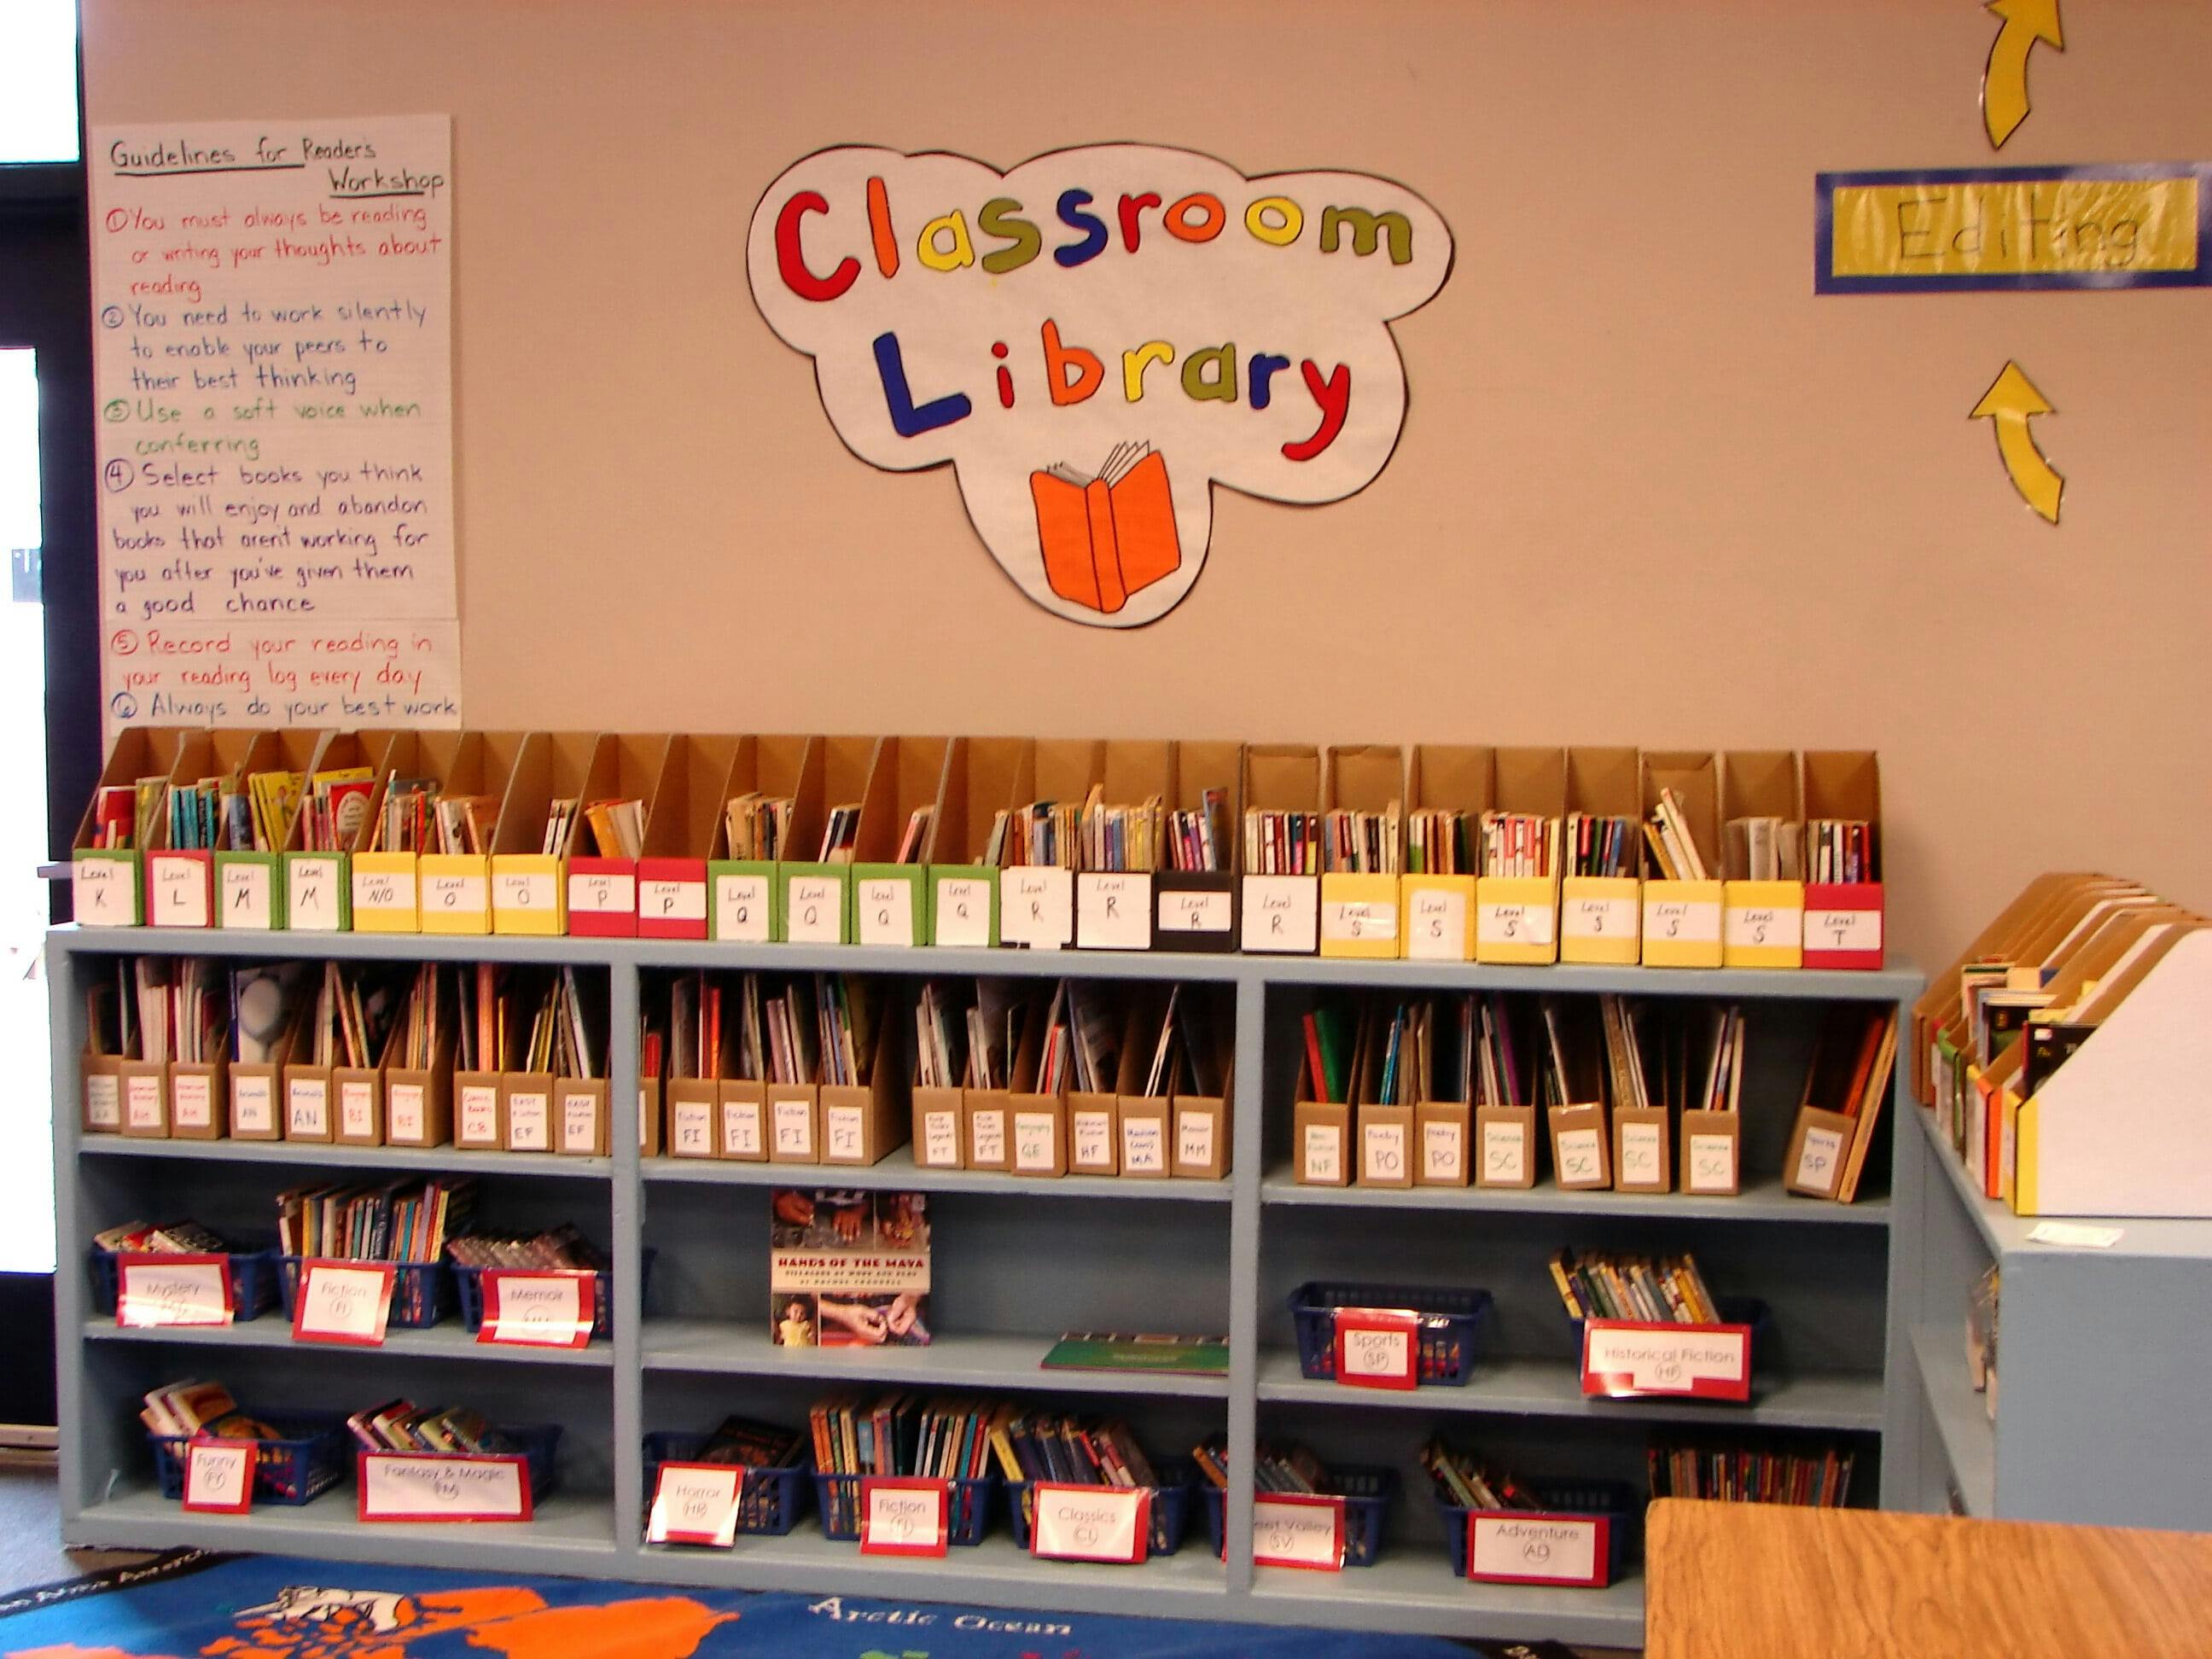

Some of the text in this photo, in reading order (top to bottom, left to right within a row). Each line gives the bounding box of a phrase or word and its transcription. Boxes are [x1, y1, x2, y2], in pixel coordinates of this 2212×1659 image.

[111, 140, 235, 167] Guidelines
[257, 137, 286, 163] for
[329, 169, 444, 199] Workshop
[129, 205, 428, 230] You must always be reading
[1897, 192, 2139, 267] Editing
[775, 177, 1412, 301] Classroom
[132, 236, 443, 268] or writing your thoughts about
[131, 275, 201, 303] reading
[129, 303, 426, 327] You need to work silently
[131, 329, 387, 364] to enable your peers to
[132, 364, 356, 395] their best thinking
[873, 318, 1352, 462] Library
[137, 399, 421, 422] Use a soft voice when
[136, 432, 259, 460] conferring
[143, 463, 422, 489] Select books you think
[130, 495, 428, 524] you will enjoy and abandon
[113, 528, 166, 550] books
[182, 526, 224, 550] that
[301, 532, 377, 556] working
[393, 523, 429, 545] for
[115, 557, 414, 591] you after you've given them
[116, 592, 315, 620] a good chance
[148, 631, 433, 661] Record your reading in
[123, 663, 423, 694] your reading log every day
[152, 693, 457, 725] Always do your best work
[81, 866, 114, 881] Level
[162, 867, 190, 882] Level
[227, 870, 254, 884] Level
[299, 865, 324, 877] Level
[362, 876, 390, 887] Level
[437, 877, 465, 889] Level
[506, 877, 530, 887] Level
[589, 876, 612, 888] Level
[655, 882, 681, 895] Level
[949, 882, 971, 896] Level
[1021, 879, 1046, 894] Level
[1097, 879, 1126, 892] Level
[95, 888, 107, 908] K
[173, 888, 186, 905] L
[236, 888, 251, 909] M
[300, 888, 319, 910] M
[369, 888, 393, 904] N/O
[444, 892, 456, 905] O
[518, 888, 530, 905] O
[598, 890, 608, 908] P
[728, 886, 755, 901] Level
[800, 887, 825, 901] Level
[871, 886, 894, 901] Level
[1263, 894, 1292, 910] Level
[663, 898, 674, 913] P
[957, 902, 968, 918] Q
[1031, 900, 1044, 923] R
[1107, 896, 1119, 918] R
[1181, 896, 1209, 910] Level
[1420, 898, 1447, 914] Level
[1495, 905, 1525, 918] Level
[1580, 901, 1610, 913] Level
[1656, 903, 1687, 917] Level
[737, 906, 748, 923] Q
[805, 907, 818, 925] Q
[878, 909, 890, 926] Q
[1190, 912, 1202, 929] R
[1339, 904, 1371, 920] Level
[1744, 910, 1773, 923] Level
[1824, 914, 1856, 927] Level
[1272, 916, 1284, 935] R
[1352, 920, 1361, 938] S
[1430, 920, 1442, 938] S
[1505, 920, 1517, 938] S
[1593, 916, 1603, 932] S
[1667, 919, 1678, 936] S
[1754, 925, 1766, 944] S
[1834, 928, 1846, 946] T
[294, 1110, 317, 1126] AN
[684, 1128, 701, 1144] FI
[731, 1129, 752, 1146] FI
[781, 1128, 802, 1144] FI
[1375, 1150, 1399, 1170] PO
[1430, 1150, 1455, 1167] PO
[778, 1259, 923, 1267] HANDS OF THE MAYA
[322, 1282, 366, 1298] Fiction
[1353, 1332, 1400, 1348] Sports
[1605, 1348, 1733, 1362] Historical Fiction
[197, 1453, 237, 1470] Funny
[879, 1499, 925, 1512] Fiction
[1058, 1507, 1116, 1522] Classics
[1496, 1525, 1579, 1540] Adventure
[808, 1597, 1071, 1635] Arctic Ocean
